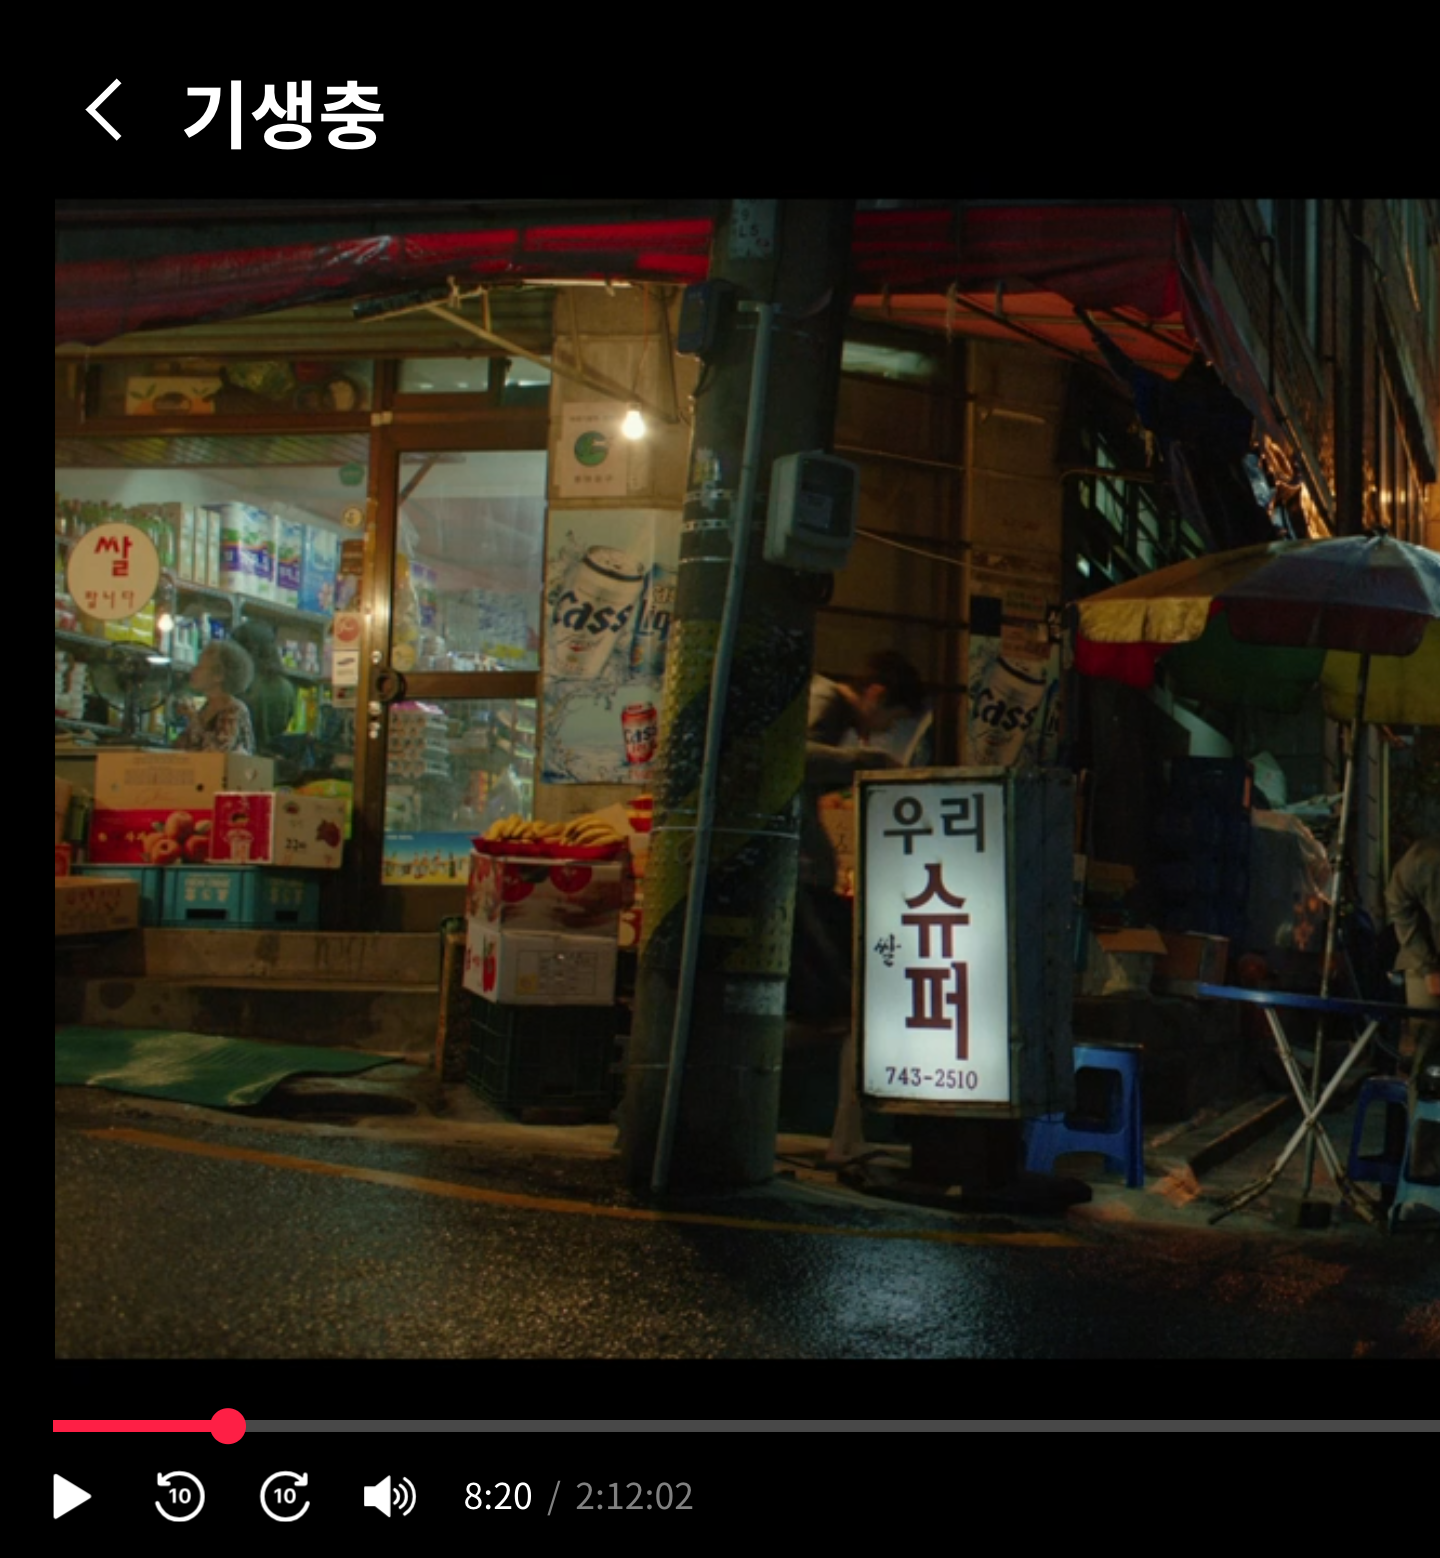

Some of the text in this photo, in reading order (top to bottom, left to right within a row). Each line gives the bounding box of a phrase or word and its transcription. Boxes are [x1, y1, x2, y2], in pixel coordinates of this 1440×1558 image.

[94, 535, 133, 577] 쌀
[549, 589, 633, 635] Cass
[882, 792, 986, 855] 우리
[900, 862, 970, 1061] 슈퍼
[885, 1066, 979, 1090] 743-2510
